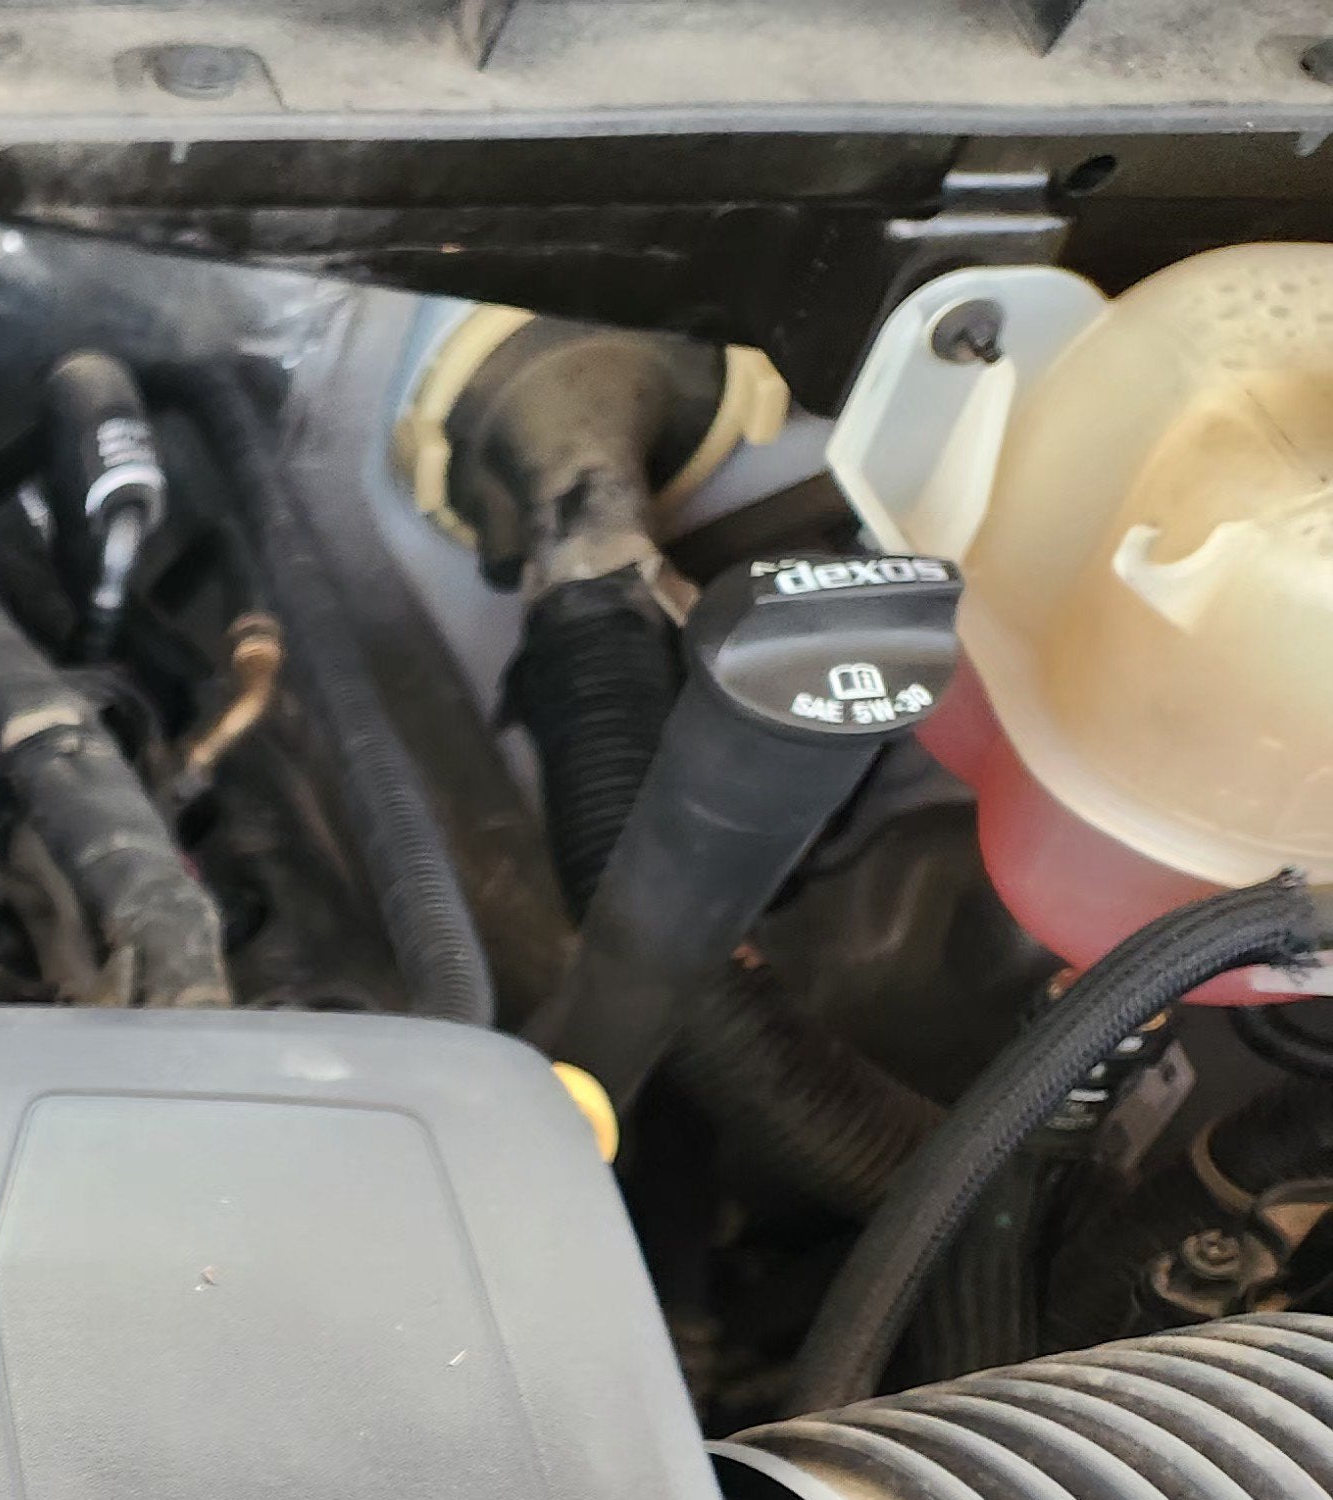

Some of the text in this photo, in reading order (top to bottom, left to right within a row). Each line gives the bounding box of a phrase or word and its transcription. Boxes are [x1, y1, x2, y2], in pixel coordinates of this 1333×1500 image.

[775, 558, 949, 595] dexos
[791, 684, 933, 724] SAE 5W-30
